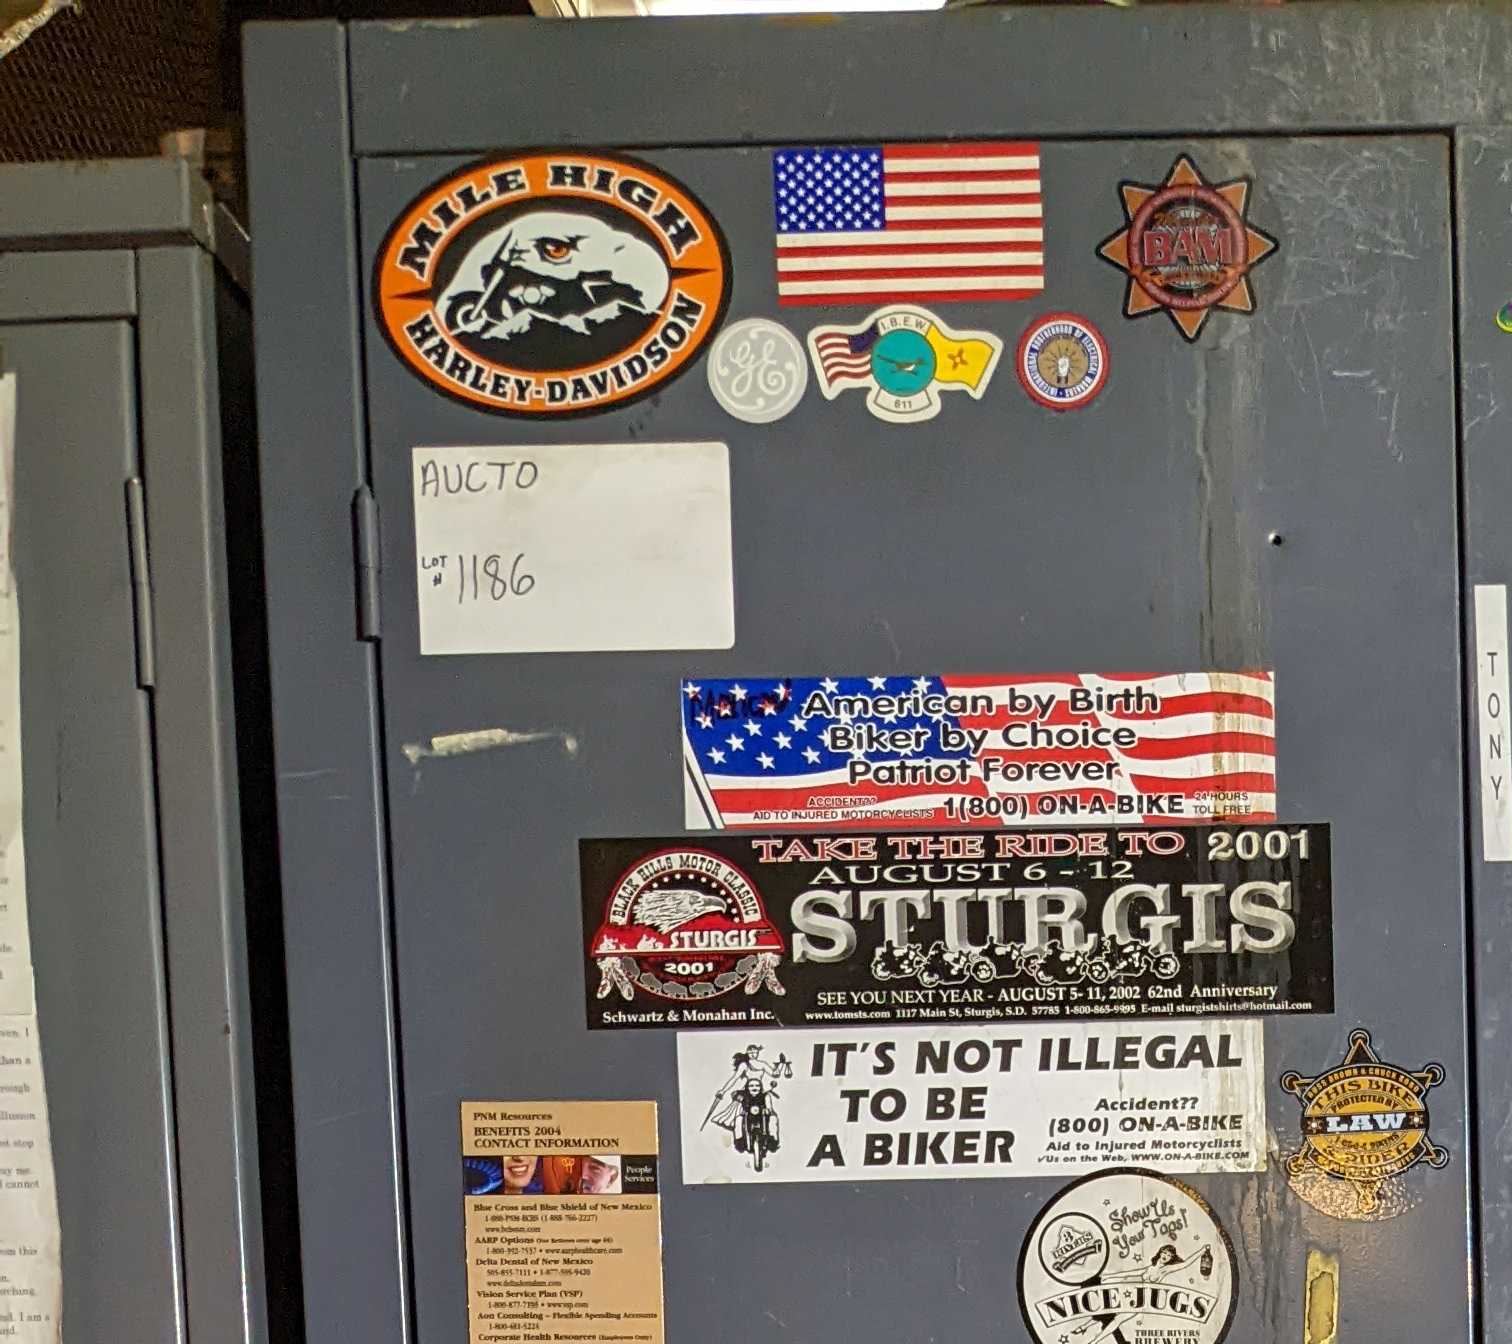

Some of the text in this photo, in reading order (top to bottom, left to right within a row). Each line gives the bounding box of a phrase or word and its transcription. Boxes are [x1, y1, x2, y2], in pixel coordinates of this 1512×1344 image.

[398, 164, 702, 280] MILE HIGH
[1143, 226, 1233, 266] BAM
[404, 292, 706, 404] HARLEY-DAVIDSON
[421, 459, 538, 498] AUCTO
[421, 554, 448, 570] LOT
[458, 553, 535, 604] 1186
[803, 689, 994, 718] American
[1008, 687, 1056, 720] by
[1070, 686, 1159, 713] Birth
[829, 721, 1137, 755] Biker by Choice
[1486, 652, 1503, 801] TONY
[850, 757, 1121, 785] Patriot Forever
[1209, 791, 1249, 801] HOURS
[753, 808, 934, 821] AID TO INJURED MOTORCYCLISTS
[943, 794, 1185, 822] 1(800) ON-A-BIKE
[1193, 805, 1251, 815] TOLL FREE
[752, 830, 1186, 864] TAKE THE RIDE TO
[1207, 829, 1310, 861] 2001
[808, 860, 1135, 885] AUGUST 6 12
[679, 854, 760, 917] MOTOR CLASSIC
[790, 880, 1297, 964] STURGIS
[669, 929, 759, 948] STURGIS
[663, 962, 714, 976] 2001
[816, 983, 1279, 1006] SEE YOU NEXT YEAR AUGUST 2002 62nd Anniversary
[602, 1007, 775, 1024] Schwartz & Monahan Inc.
[804, 1009, 891, 1021] www.tomsts.com
[896, 1008, 918, 1018] 1117
[919, 1007, 947, 1018] Main
[964, 1006, 1003, 1019] Sturgis,
[1005, 1005, 1028, 1016] S.D.
[1140, 1003, 1175, 1014] E-mail
[810, 1034, 1243, 1077] IT'S NOT ILLEGAL
[840, 1086, 989, 1123] TO BE
[1094, 1096, 1199, 1112] Accident??
[1311, 1079, 1416, 1111] THIS BIKE
[1330, 1094, 1386, 1112] PROTECTED
[473, 1111, 553, 1121] PNM Resources
[1049, 1114, 1244, 1137] (800) ON-A-BIKE
[1326, 1112, 1407, 1133] LAW
[474, 1126, 561, 1137] BENEFITS 2004
[474, 1137, 620, 1149] CONTACT INFORMATION
[806, 1130, 1016, 1168] A BIKER
[1046, 1138, 1243, 1153] Aid to Injured Motorcyclists
[1080, 1154, 1098, 1163] the
[1101, 1154, 1129, 1164] Web,
[1130, 1151, 1250, 1162] WWW.ON-A-BIKE.COM
[624, 1174, 655, 1183] Services
[626, 1165, 653, 1176] People
[494, 1202, 653, 1211] Cross and Shield New Mexico
[1108, 1205, 1151, 1233] Show
[475, 1236, 499, 1245] AARP
[500, 1236, 534, 1246] Options
[1112, 1230, 1146, 1259] Your
[500, 1257, 594, 1266] Dental New Mexico
[476, 1290, 557, 1299] Vision Service Plan
[1045, 1286, 1211, 1323] NICE JUGS
[478, 1333, 521, 1343] Corporate
[523, 1333, 552, 1341] Health
[1135, 1329, 1201, 1337] THREE RIVERS
